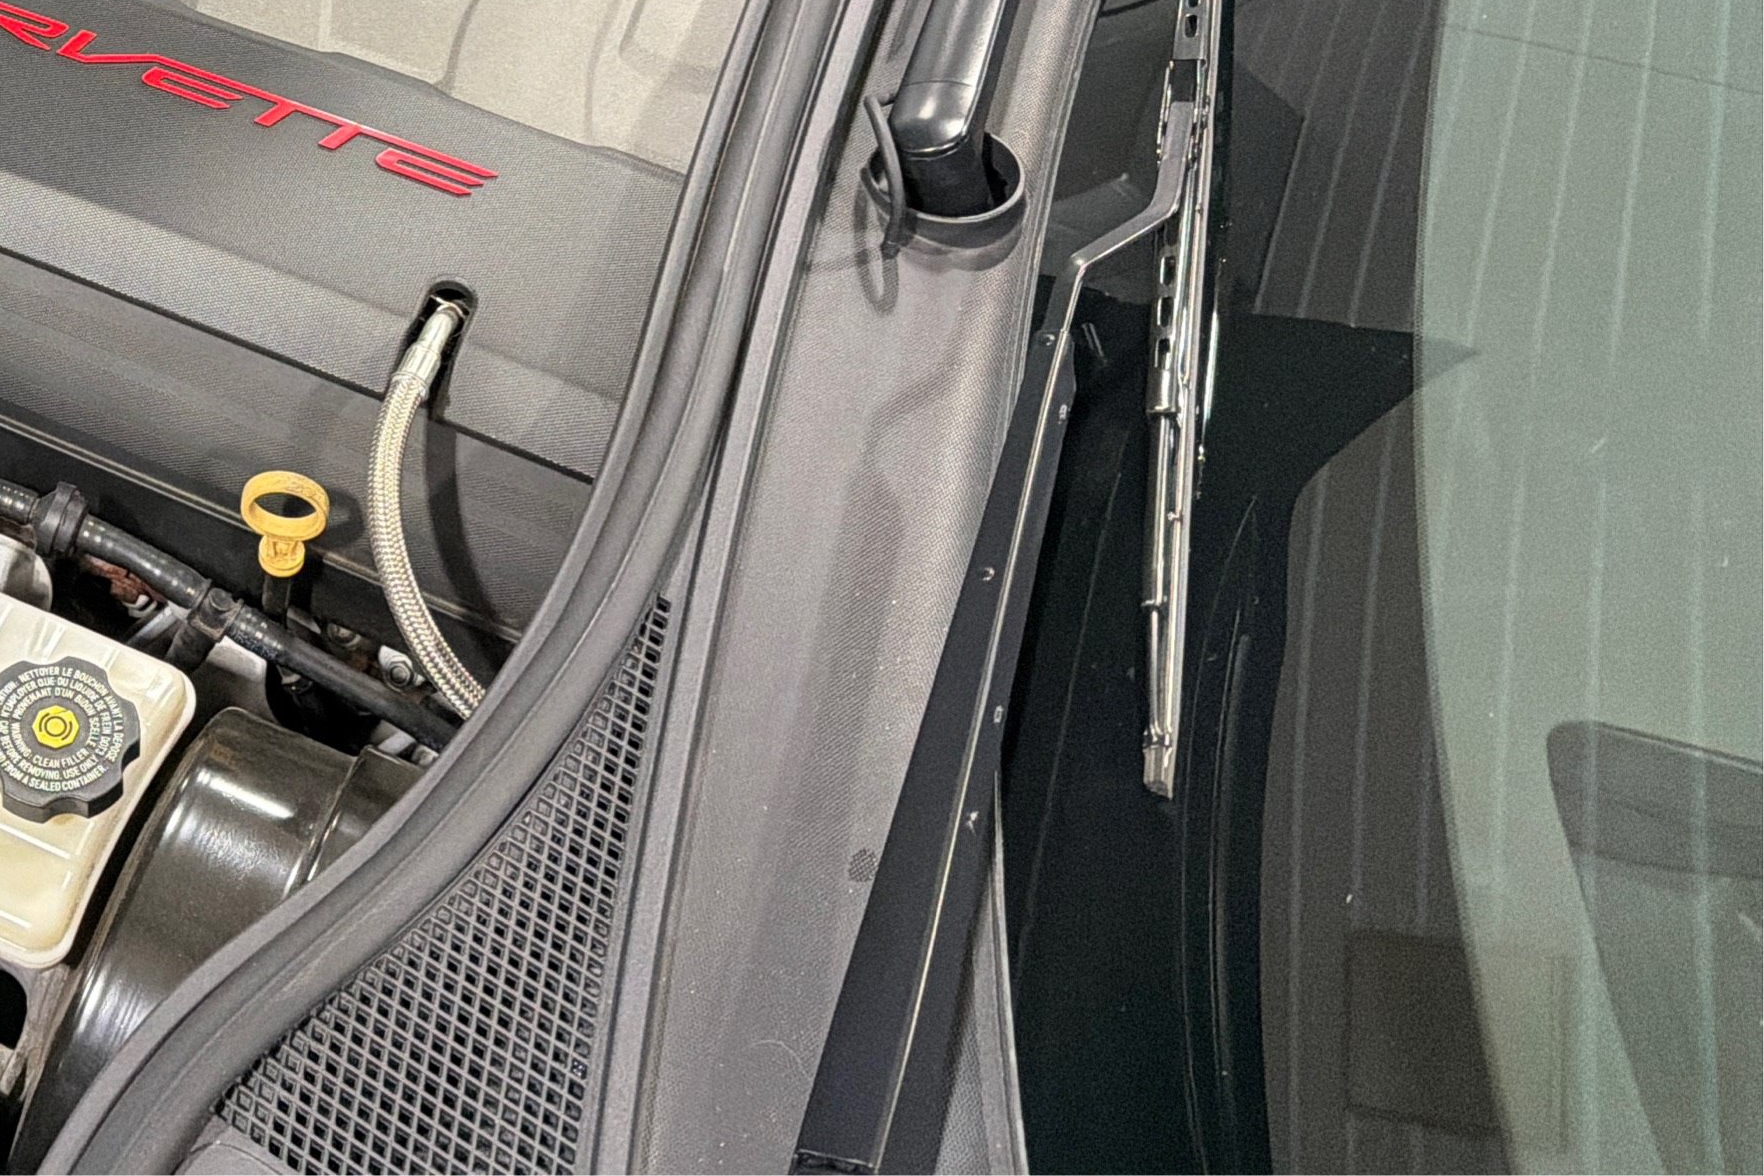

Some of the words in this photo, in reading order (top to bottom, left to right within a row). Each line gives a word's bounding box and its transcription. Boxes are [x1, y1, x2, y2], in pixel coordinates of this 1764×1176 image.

[11, 687, 52, 720] PROVENANT
[18, 666, 60, 684] NETTOYER
[61, 667, 74, 678] LE
[73, 670, 109, 697] BOUCHON
[103, 695, 123, 718] AVANT
[113, 720, 124, 731] LA
[94, 699, 108, 712] DE
[99, 711, 112, 735] FREIN
[0, 735, 23, 764] BEFORE
[62, 766, 82, 780] USE
[79, 754, 99, 773] ONLY
[32, 755, 61, 769] CLEAN
[61, 747, 90, 769] FILLER
[0, 760, 25, 782] FROM
[21, 775, 30, 786] A
[28, 777, 62, 793] SEALED
